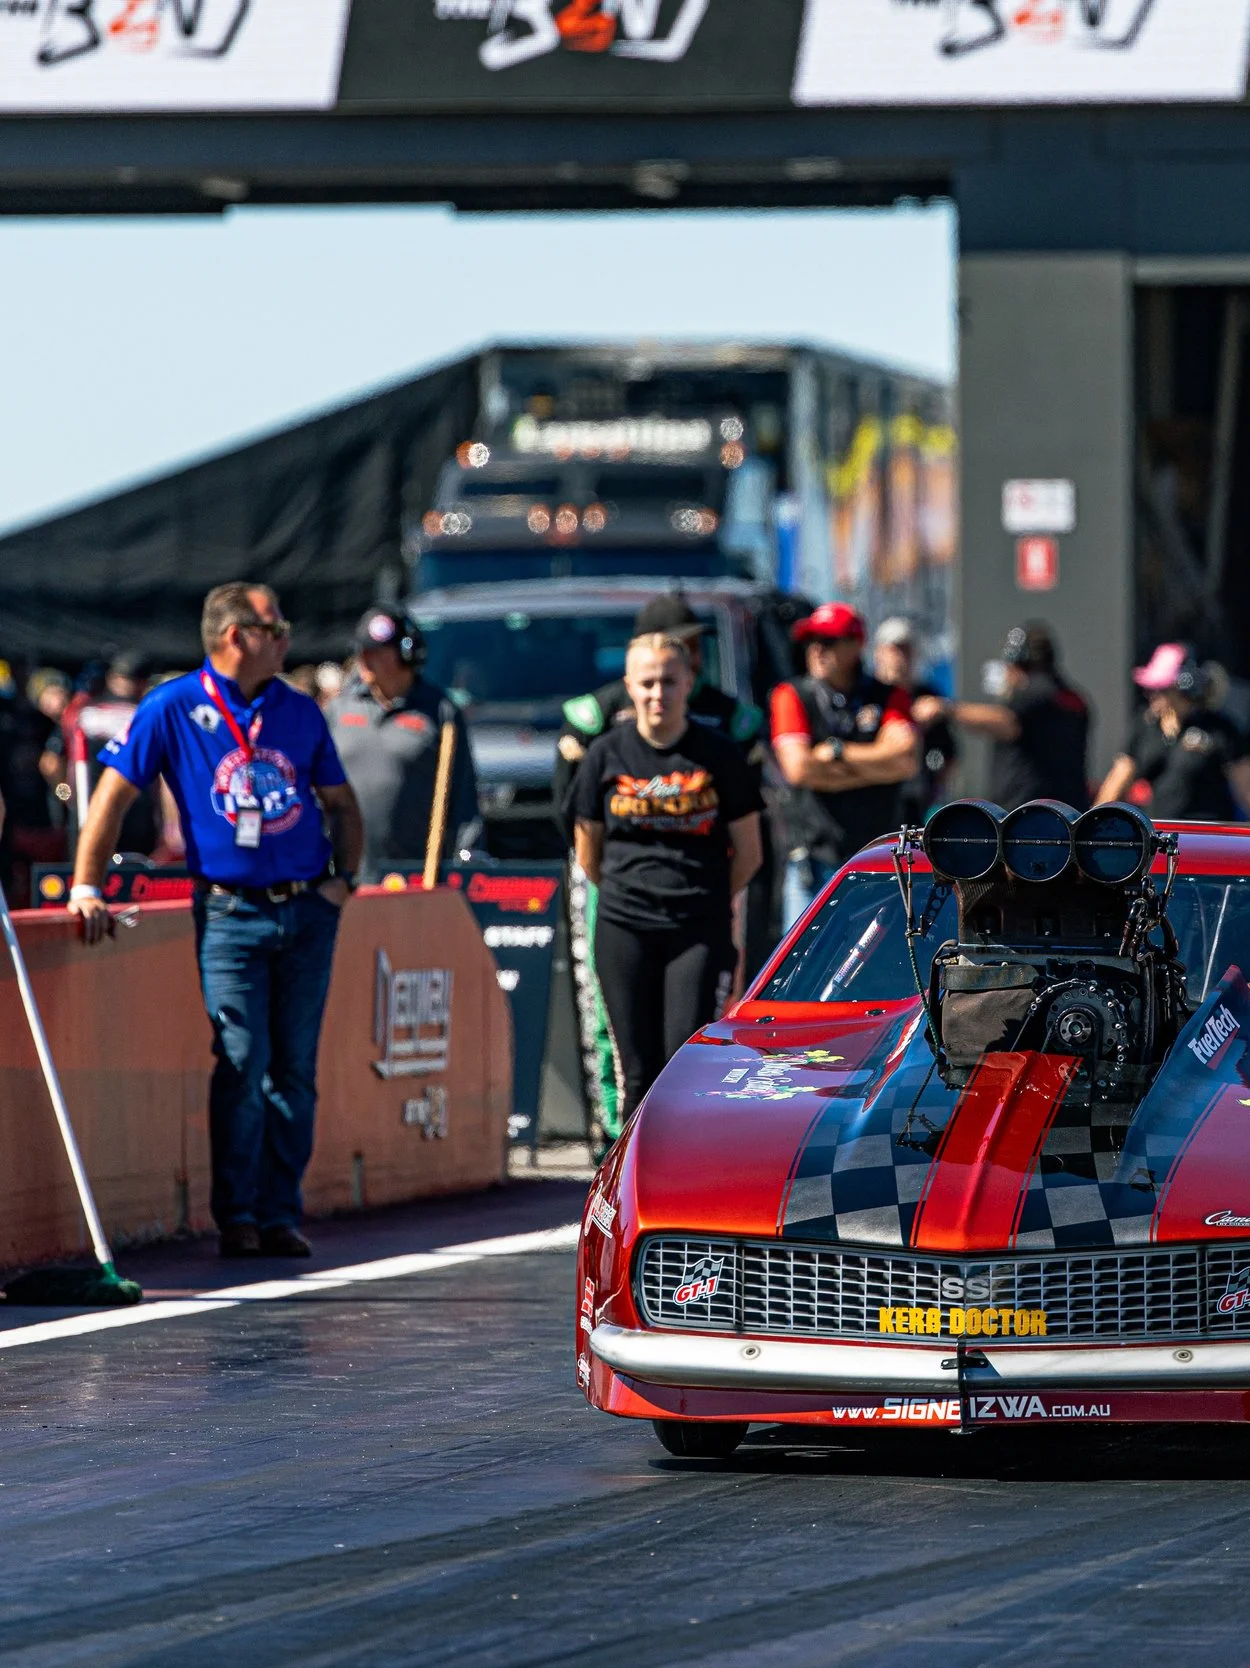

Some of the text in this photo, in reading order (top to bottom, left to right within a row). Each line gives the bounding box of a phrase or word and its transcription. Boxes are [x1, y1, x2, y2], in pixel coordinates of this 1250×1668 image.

[1188, 1004, 1241, 1065] FuelTech
[674, 1275, 719, 1304] GT-1
[941, 1277, 991, 1300] SS
[878, 1306, 1048, 1337] KERB DOCTOR
